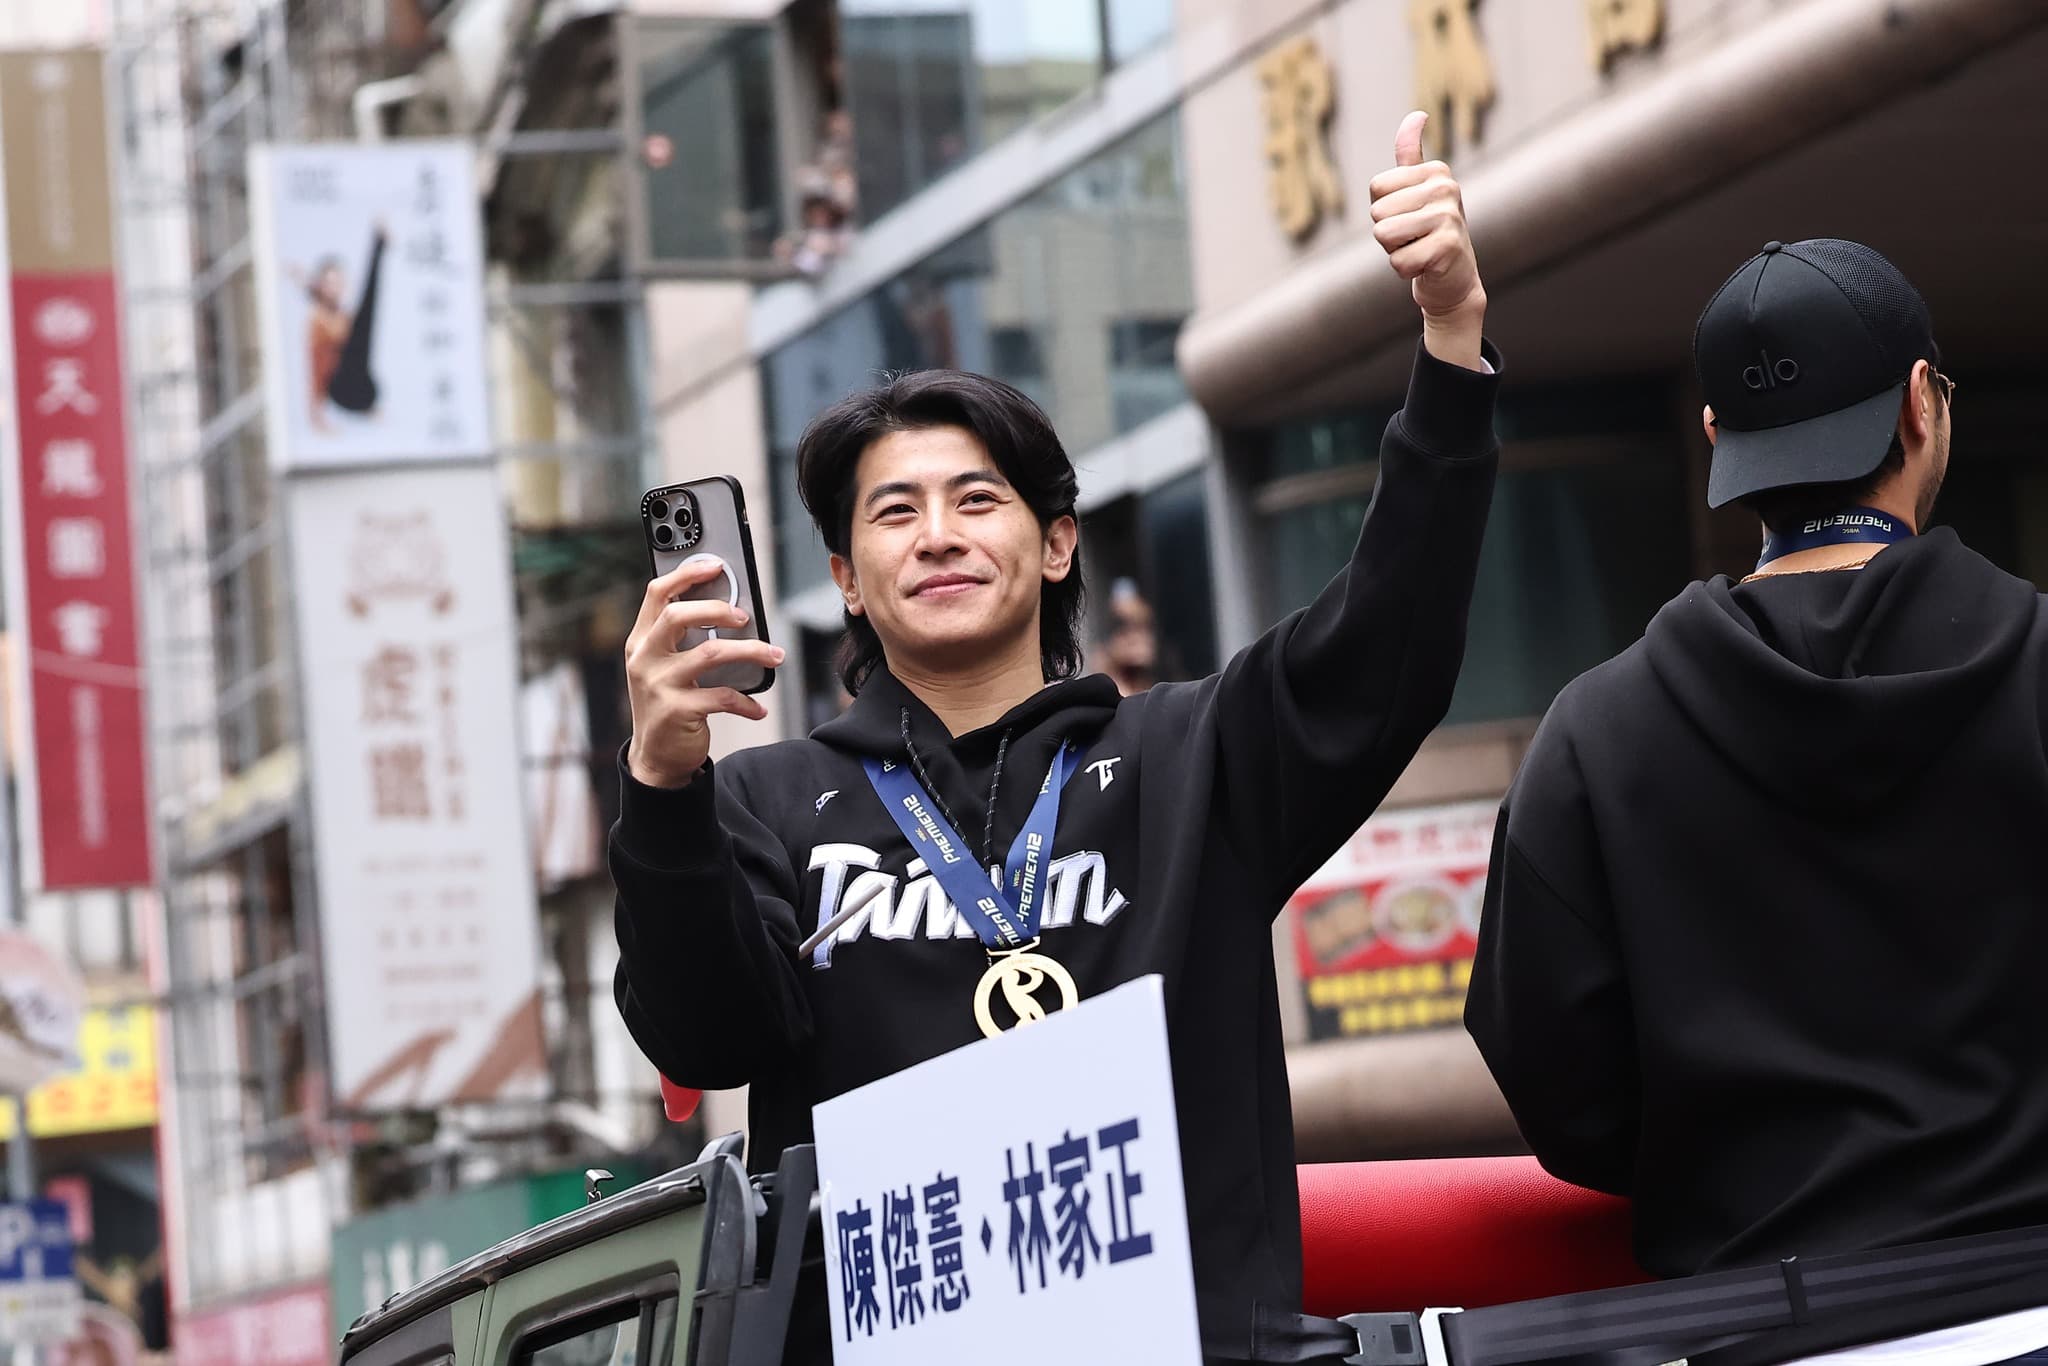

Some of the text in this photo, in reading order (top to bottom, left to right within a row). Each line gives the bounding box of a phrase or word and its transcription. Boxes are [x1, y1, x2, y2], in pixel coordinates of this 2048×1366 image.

[1742, 349, 1800, 390] alo
[1803, 514, 1892, 534] PREMIER12
[903, 794, 961, 864] PREMIER12
